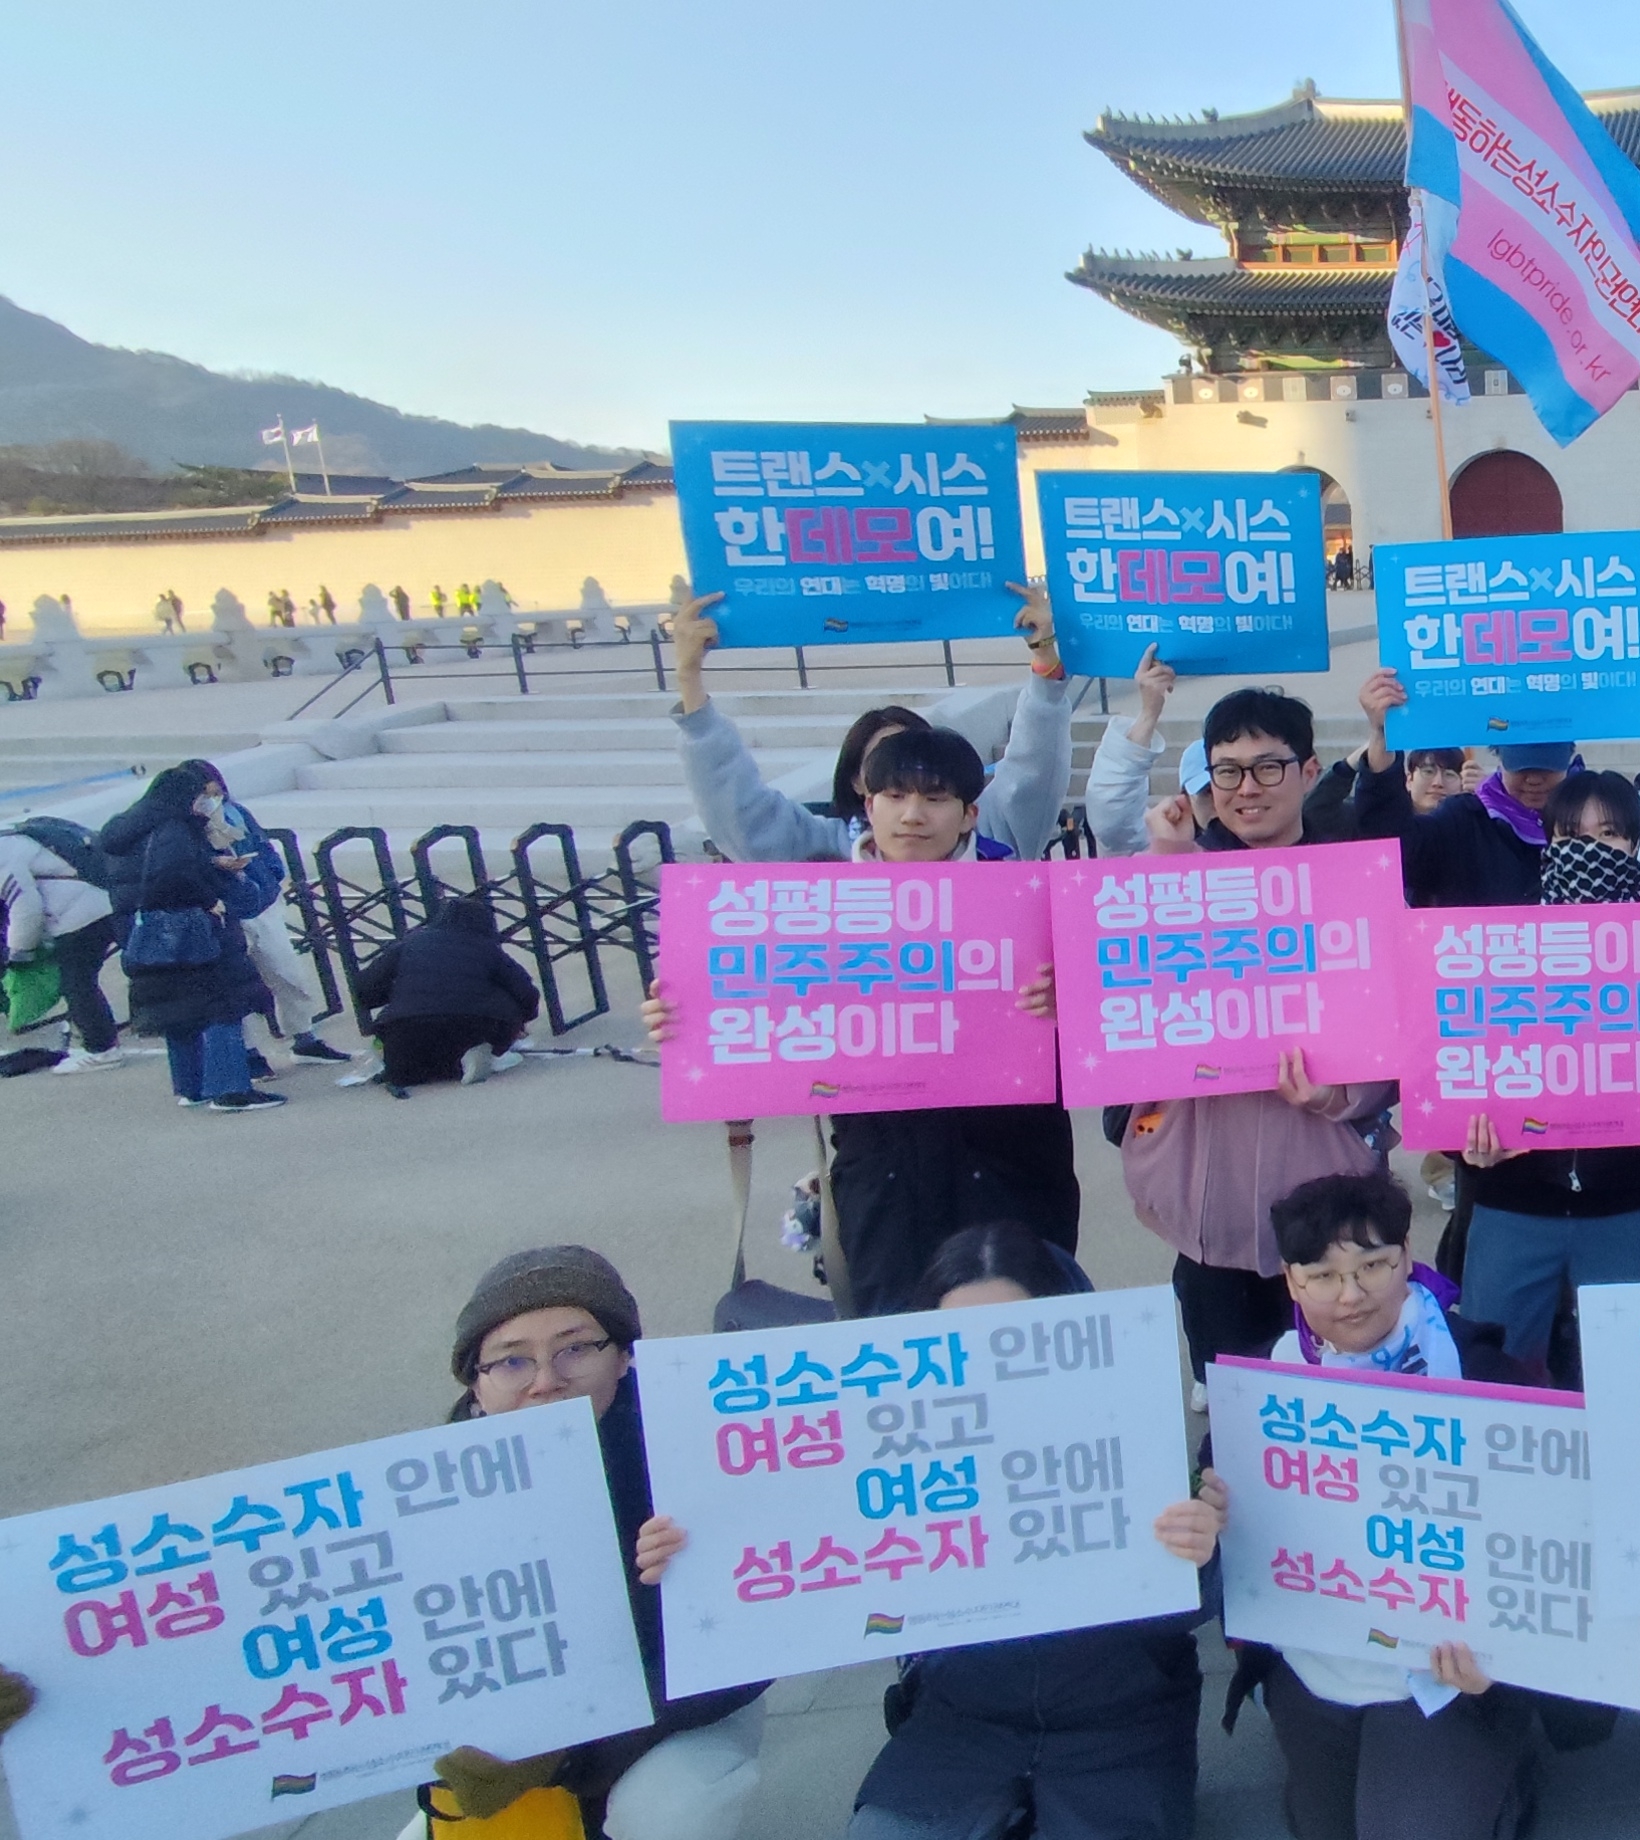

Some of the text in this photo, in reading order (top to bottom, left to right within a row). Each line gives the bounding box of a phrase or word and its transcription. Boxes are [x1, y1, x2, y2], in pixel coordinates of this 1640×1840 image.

[1487, 229, 1612, 382] lgbtpride.or.kr
[714, 505, 995, 568] 한데모여!
[733, 577, 796, 597] 우리의
[800, 576, 862, 596] 연대는
[865, 574, 925, 594] 혁명의
[1065, 546, 1297, 607] 한데모여!
[1080, 613, 1123, 631] 우리의
[1126, 614, 1174, 633] 연대는
[1178, 615, 1231, 634] 혁명의
[1403, 605, 1640, 671] 한데모여!
[1414, 678, 1467, 698] 우리의
[1470, 676, 1522, 696] 연대는
[1526, 672, 1577, 692] 혁명의
[708, 877, 954, 937] 성평등이
[1093, 862, 1313, 930] 성평등이
[707, 938, 1014, 1000] 민주주의의
[1096, 917, 1371, 989] 민주주의의
[708, 1001, 960, 1065] 완성이다
[1099, 981, 1325, 1053] 완성이다
[708, 1314, 1115, 1414] 성소수자 안에
[715, 1392, 994, 1476] 여성 있고
[1259, 1394, 1590, 1480] 성소수자 안에
[49, 1434, 532, 1594] 성소수자 안에
[856, 1436, 1125, 1520] 여성 안에
[1263, 1445, 1482, 1521] 여성 있고
[733, 1497, 1131, 1603] 성소수자 있다
[1366, 1514, 1591, 1591] 여성 안에
[63, 1531, 404, 1657] 여성 있고
[242, 1559, 557, 1680] 여성 안에
[1271, 1547, 1593, 1643] 성소수자 있다
[102, 1621, 568, 1788] 성소수자 있다
